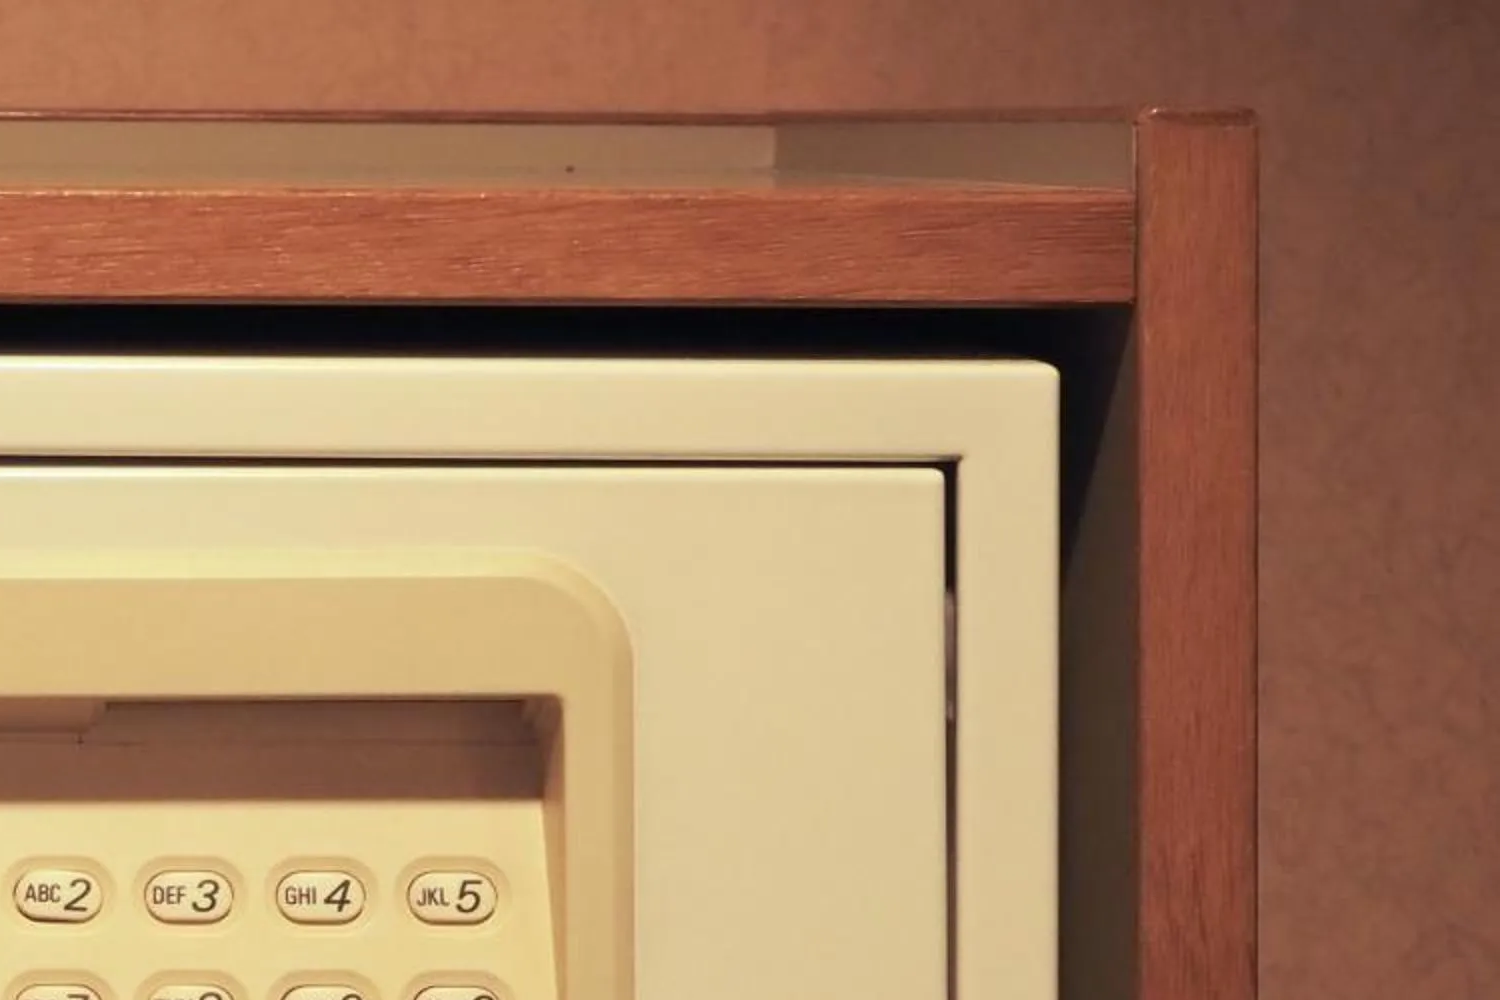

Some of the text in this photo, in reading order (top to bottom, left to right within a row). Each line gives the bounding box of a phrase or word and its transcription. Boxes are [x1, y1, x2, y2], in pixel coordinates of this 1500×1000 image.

[24, 879, 91, 911] ABC 2
[153, 879, 219, 911] DEF 3
[285, 880, 352, 911] GHI 4
[417, 880, 482, 912] JKL 5
